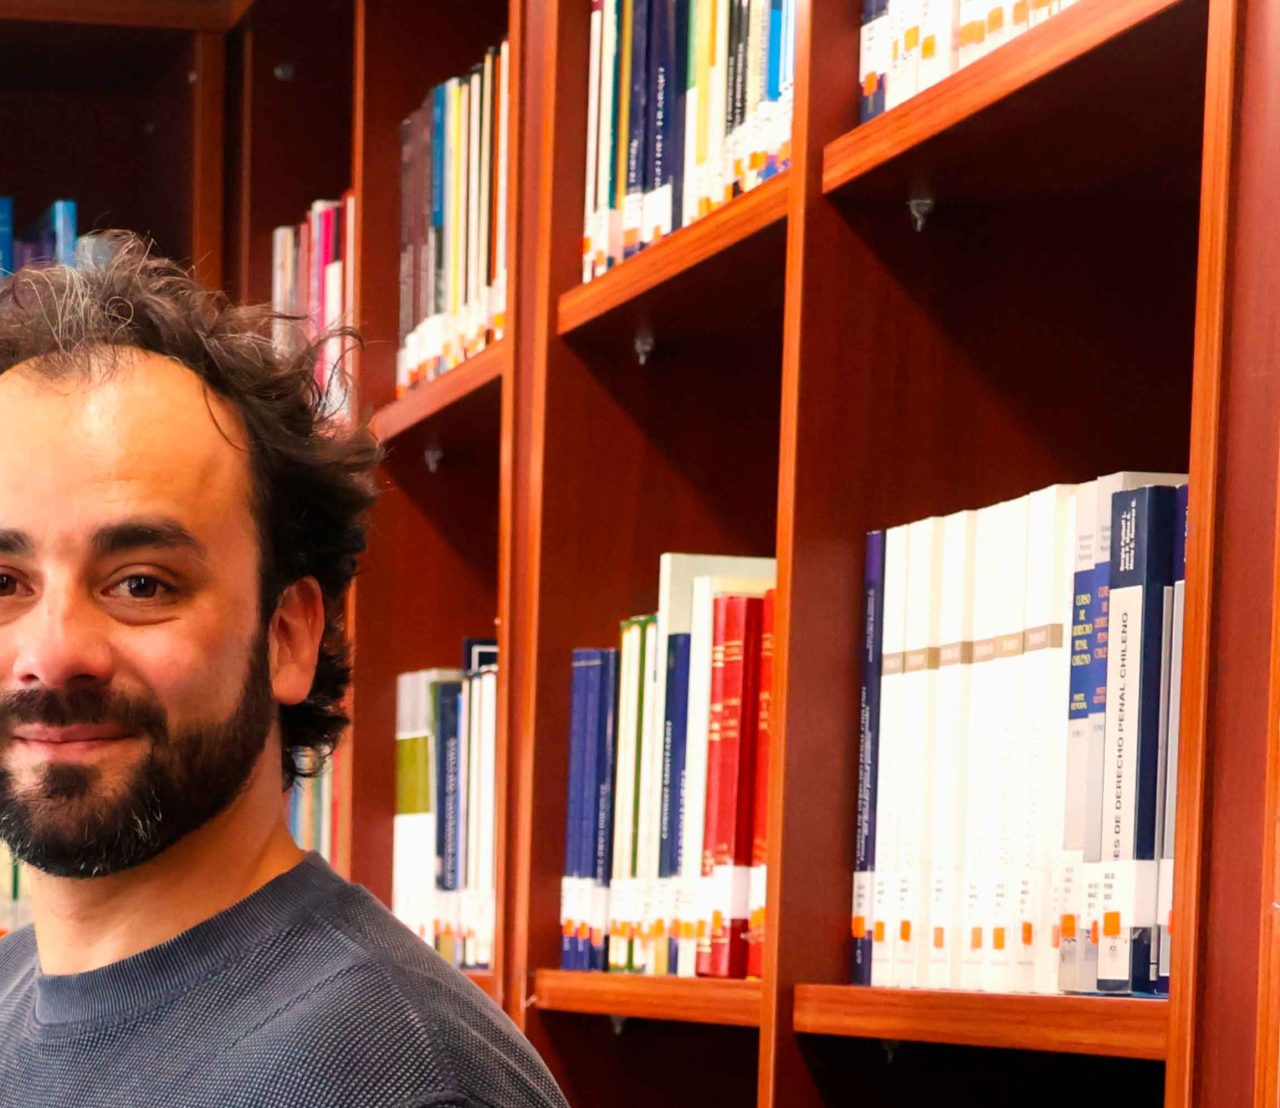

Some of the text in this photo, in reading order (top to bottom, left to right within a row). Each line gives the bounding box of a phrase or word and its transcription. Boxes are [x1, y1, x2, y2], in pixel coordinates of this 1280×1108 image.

[1119, 611, 1129, 679] CHILENO
[1117, 683, 1126, 733] PENAL
[1115, 736, 1124, 810] DERECHO
[1114, 815, 1122, 835] DE
